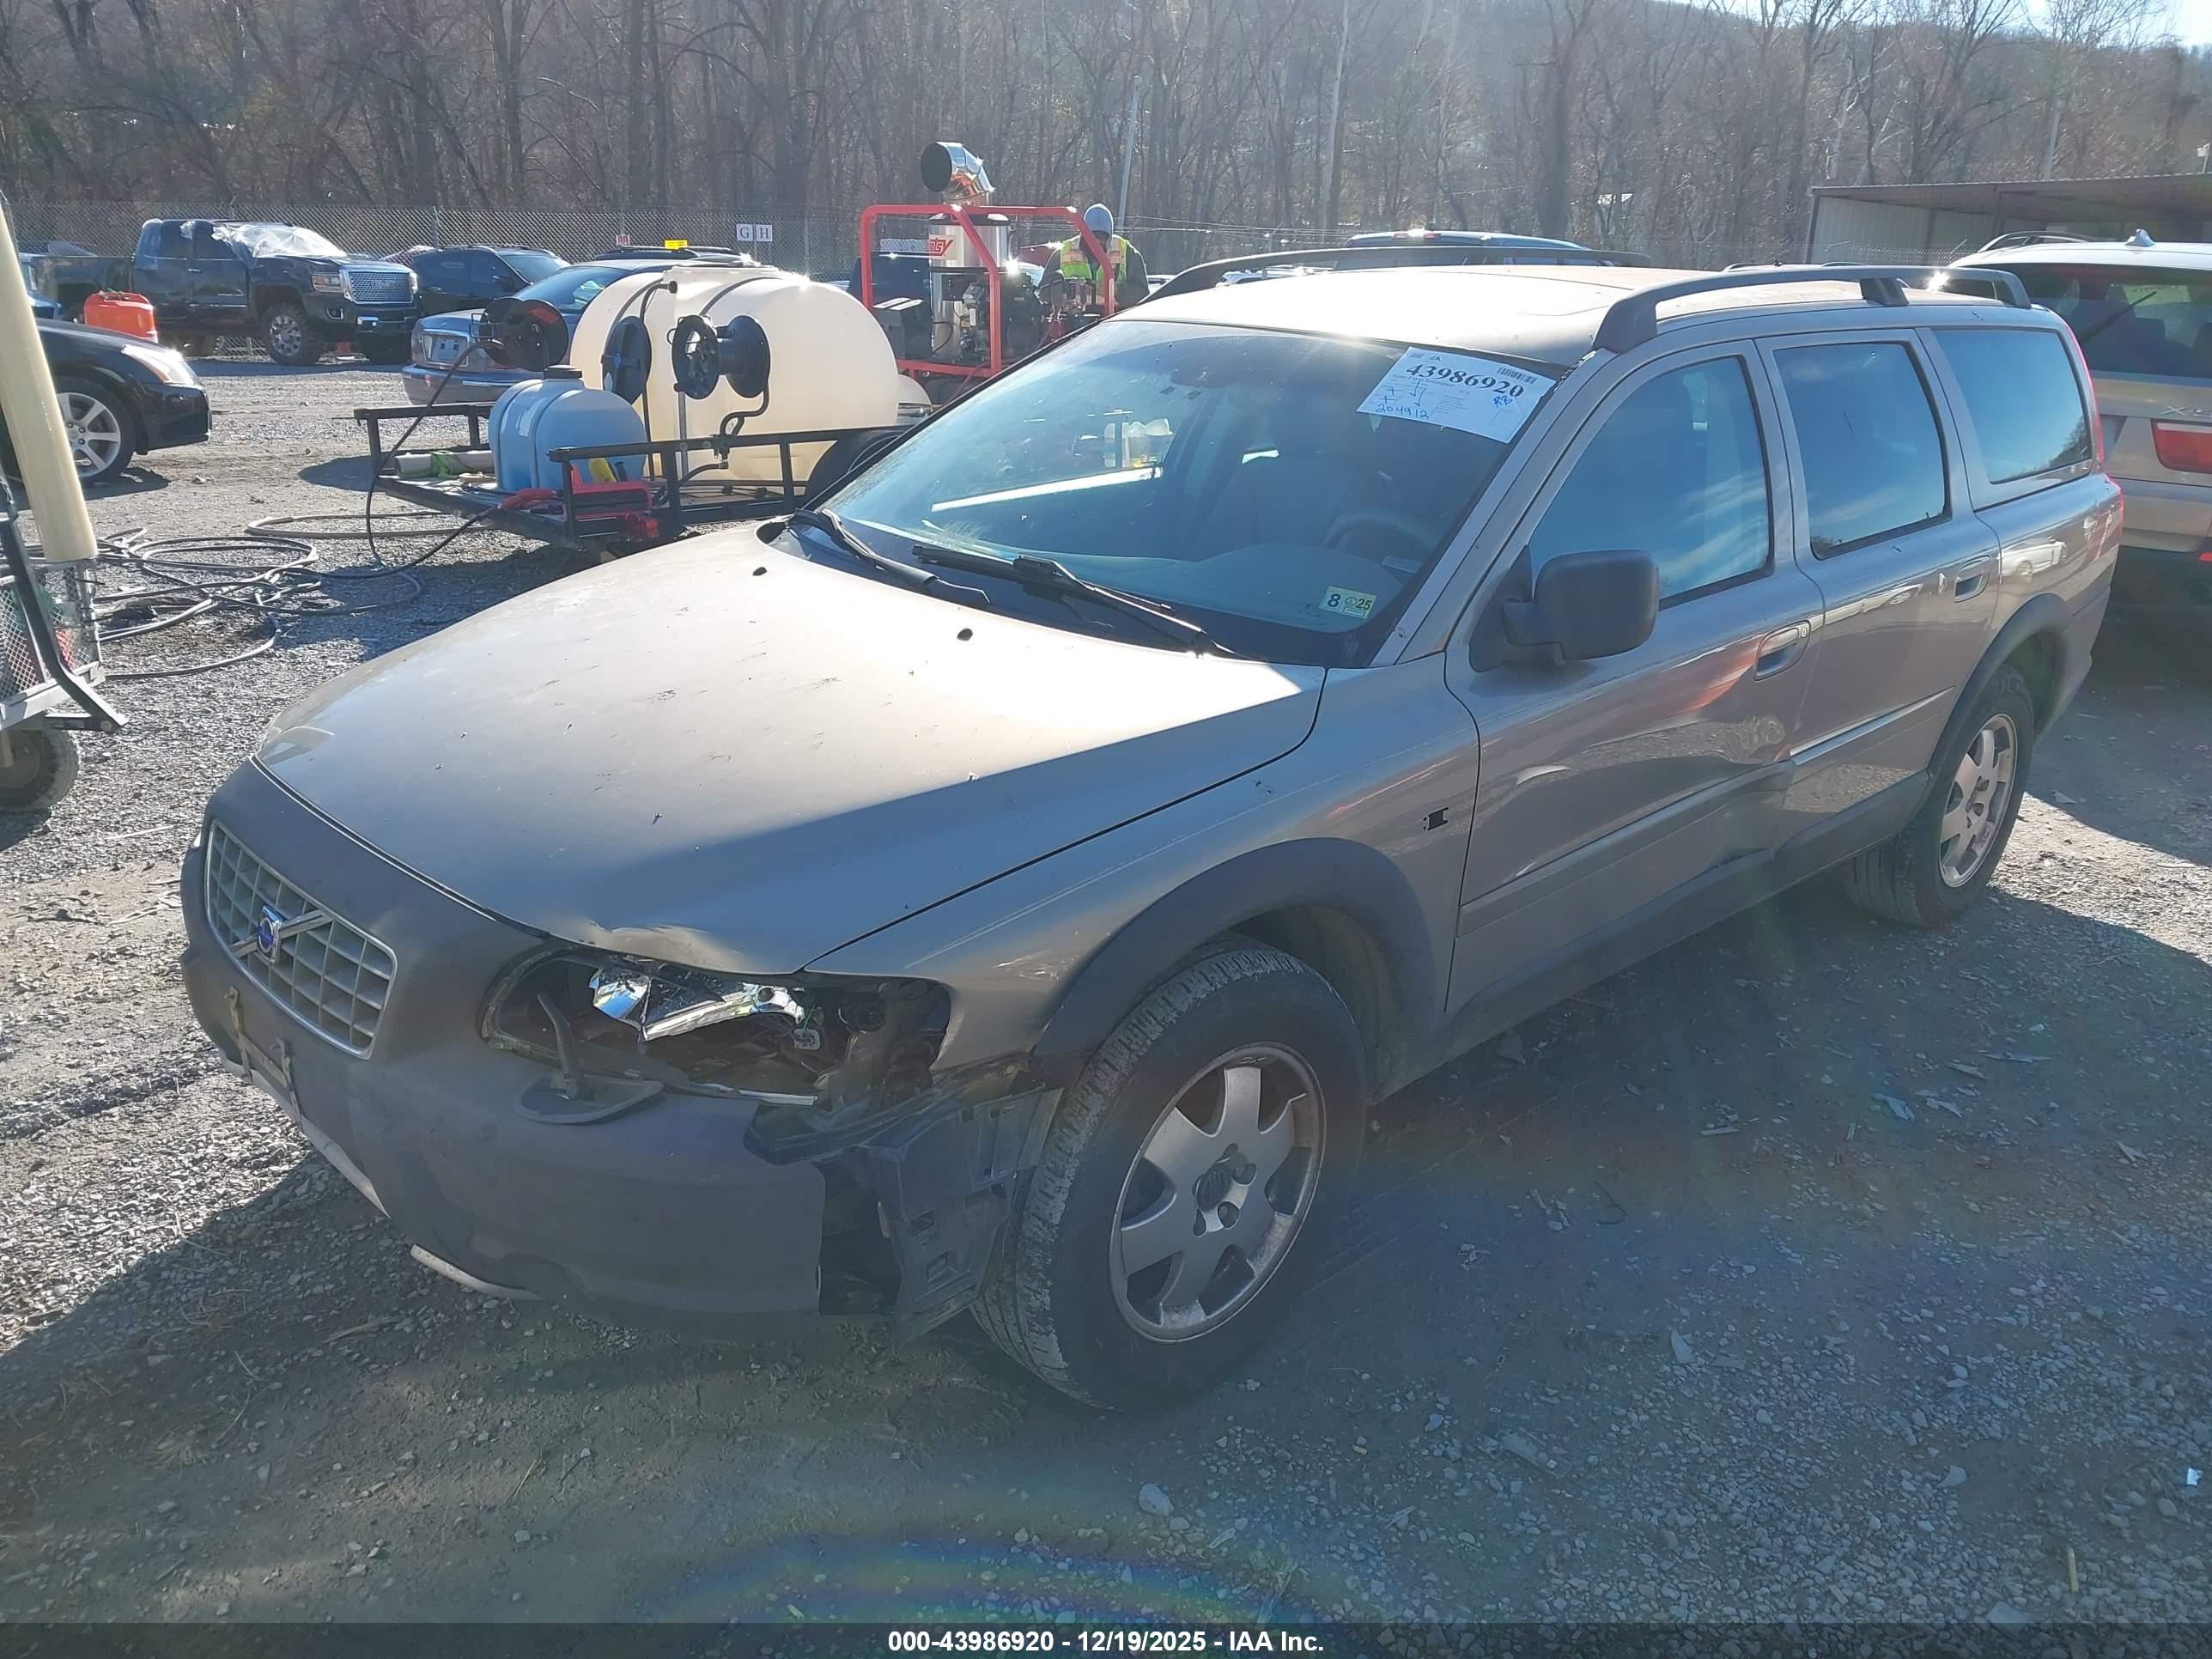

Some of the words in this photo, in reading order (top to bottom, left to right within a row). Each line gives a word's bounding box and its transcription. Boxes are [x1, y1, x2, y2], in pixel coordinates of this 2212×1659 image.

[739, 227, 750, 239] G
[759, 227, 769, 239] H
[1406, 363, 1524, 398] 43986920
[1328, 593, 1341, 607] 8
[1356, 598, 1373, 611] 25
